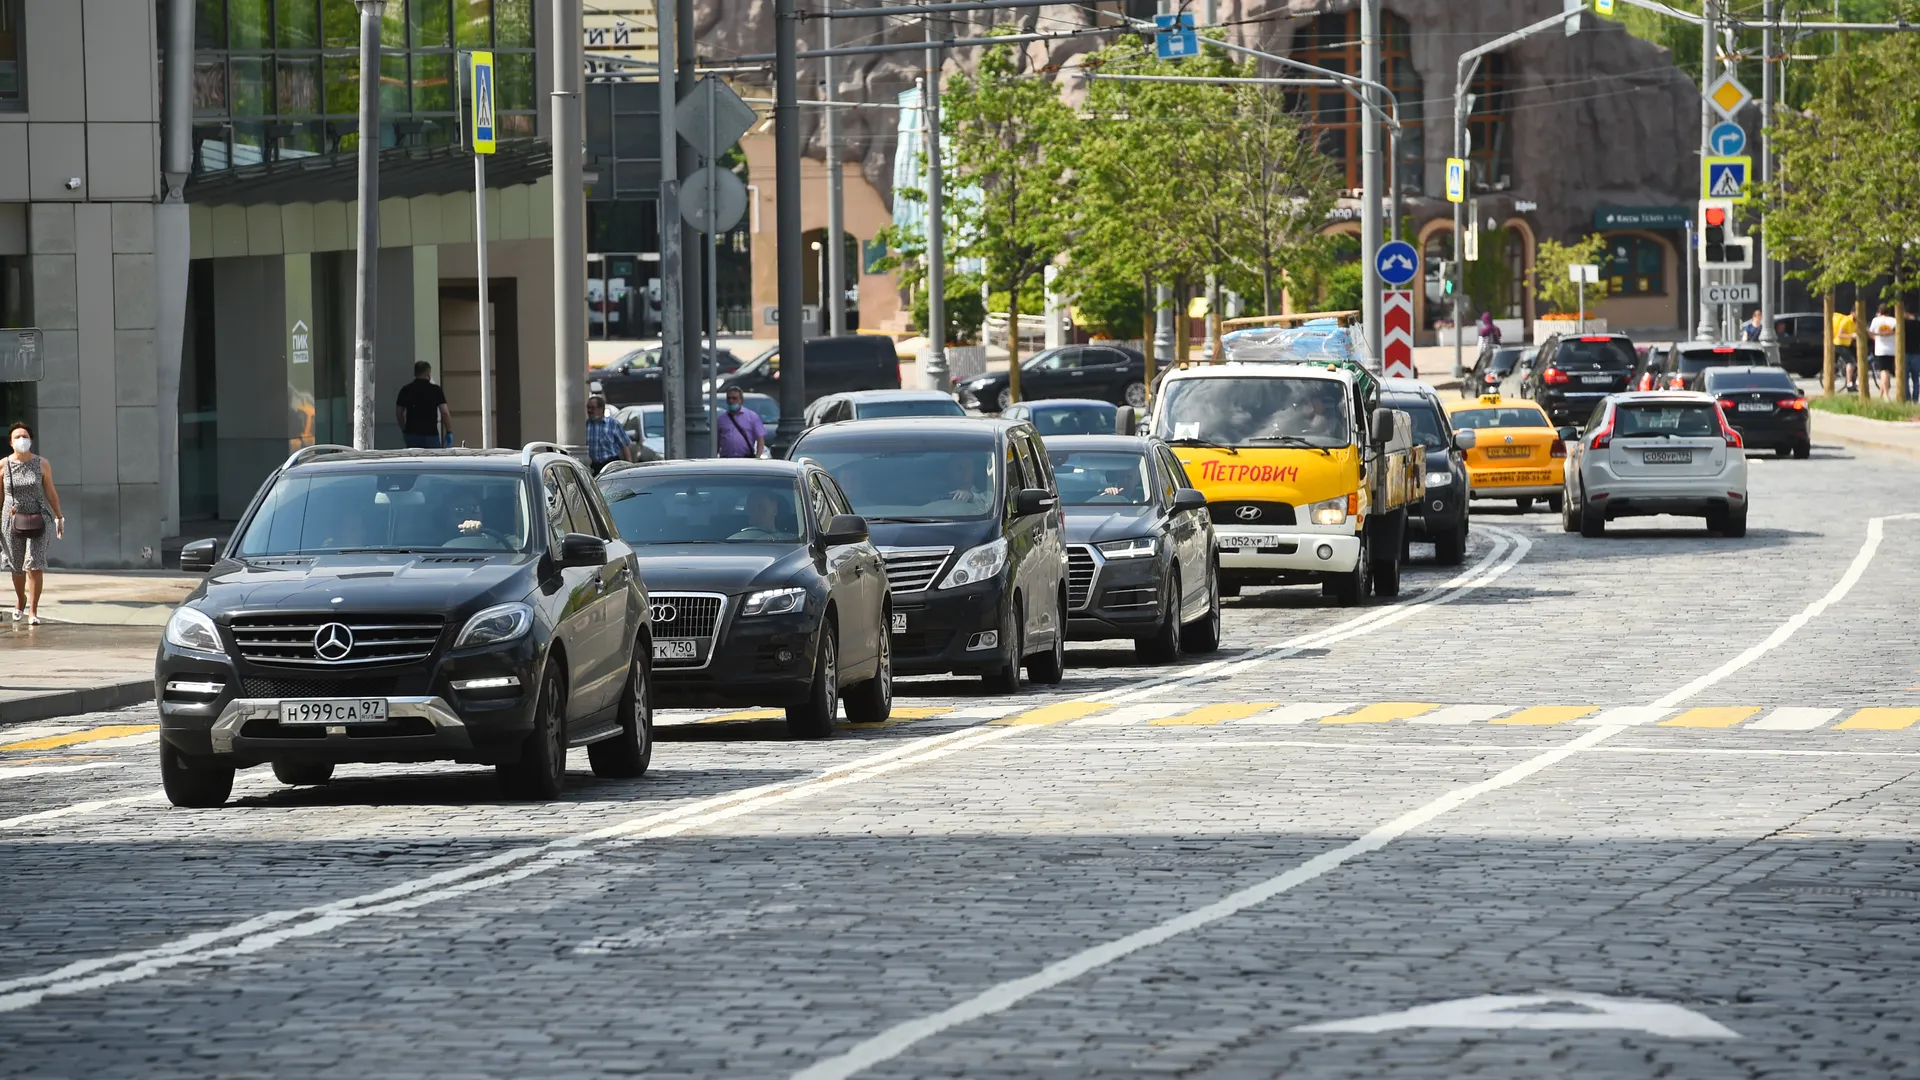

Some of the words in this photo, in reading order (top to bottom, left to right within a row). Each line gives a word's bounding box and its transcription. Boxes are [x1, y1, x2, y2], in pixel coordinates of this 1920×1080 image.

[1709, 287, 1750, 301] СТОП
[292, 334, 308, 350] ПИК
[1225, 536, 1262, 547] Т052ХР
[670, 641, 692, 653] 750
[287, 703, 357, 721] Н999СА
[362, 701, 380, 714] 97
